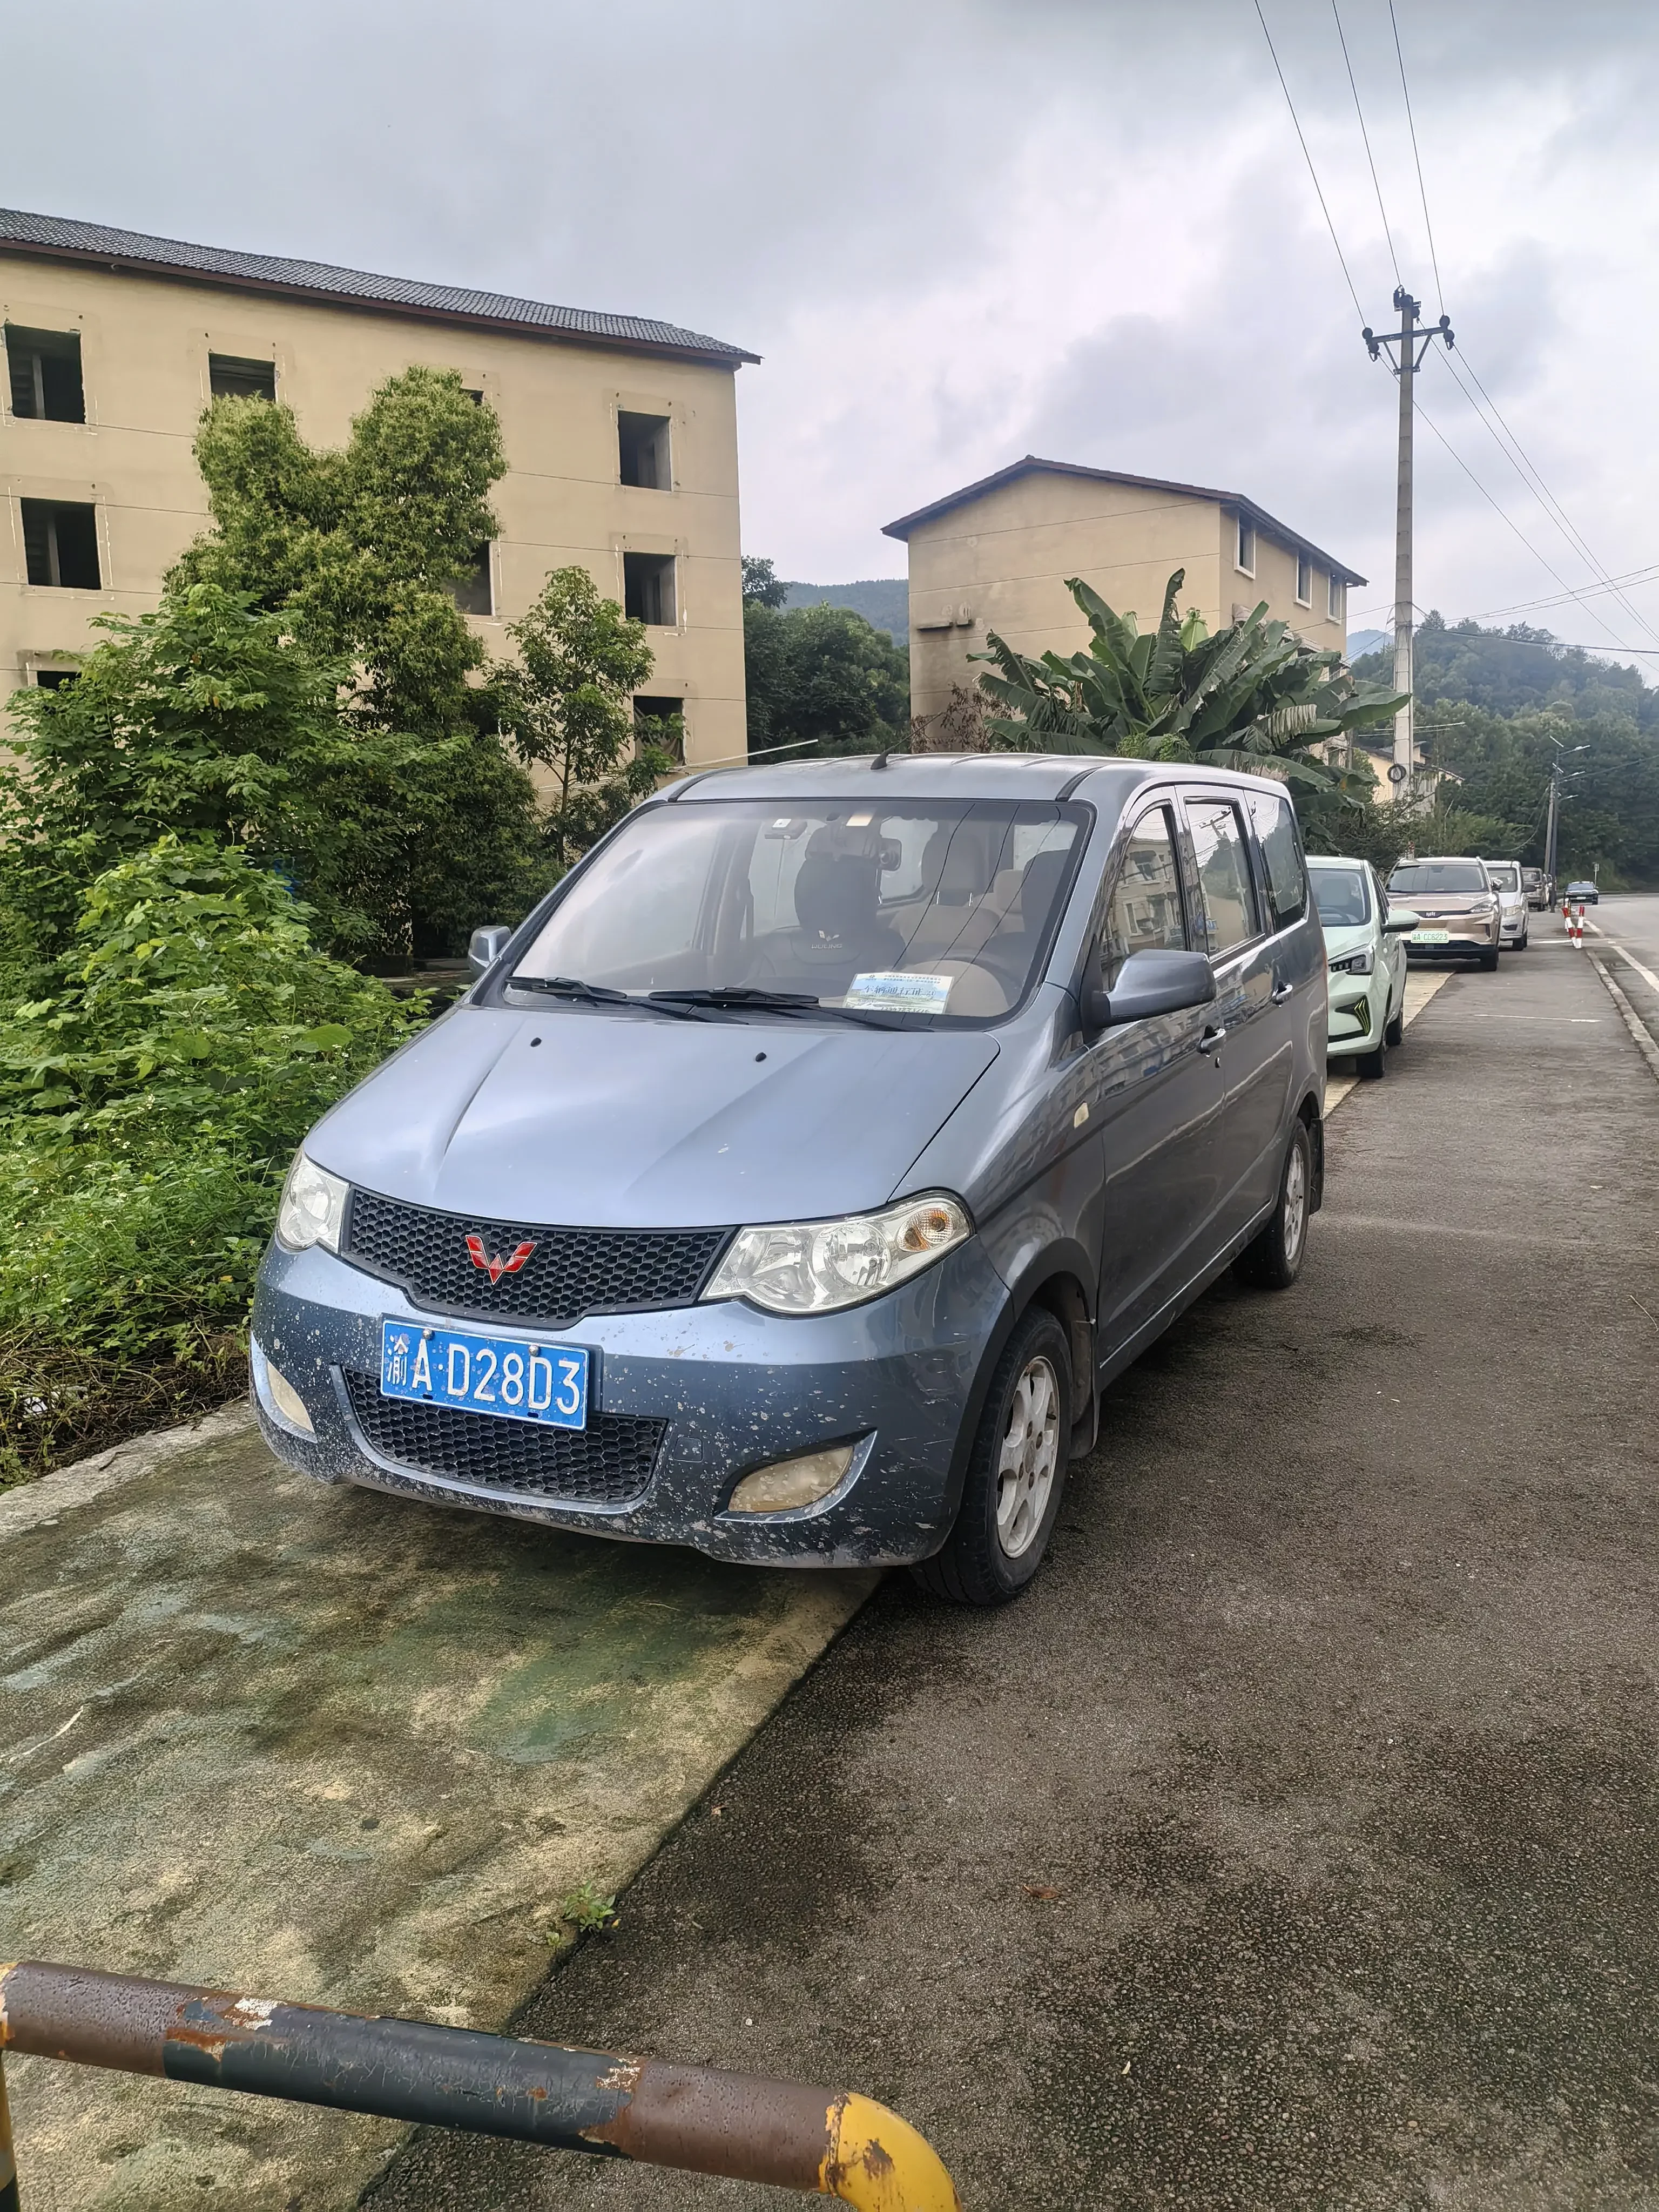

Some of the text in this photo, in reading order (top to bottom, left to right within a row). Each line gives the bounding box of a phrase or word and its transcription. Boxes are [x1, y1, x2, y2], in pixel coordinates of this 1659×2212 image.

[864, 984, 923, 996] 车辆通行证
